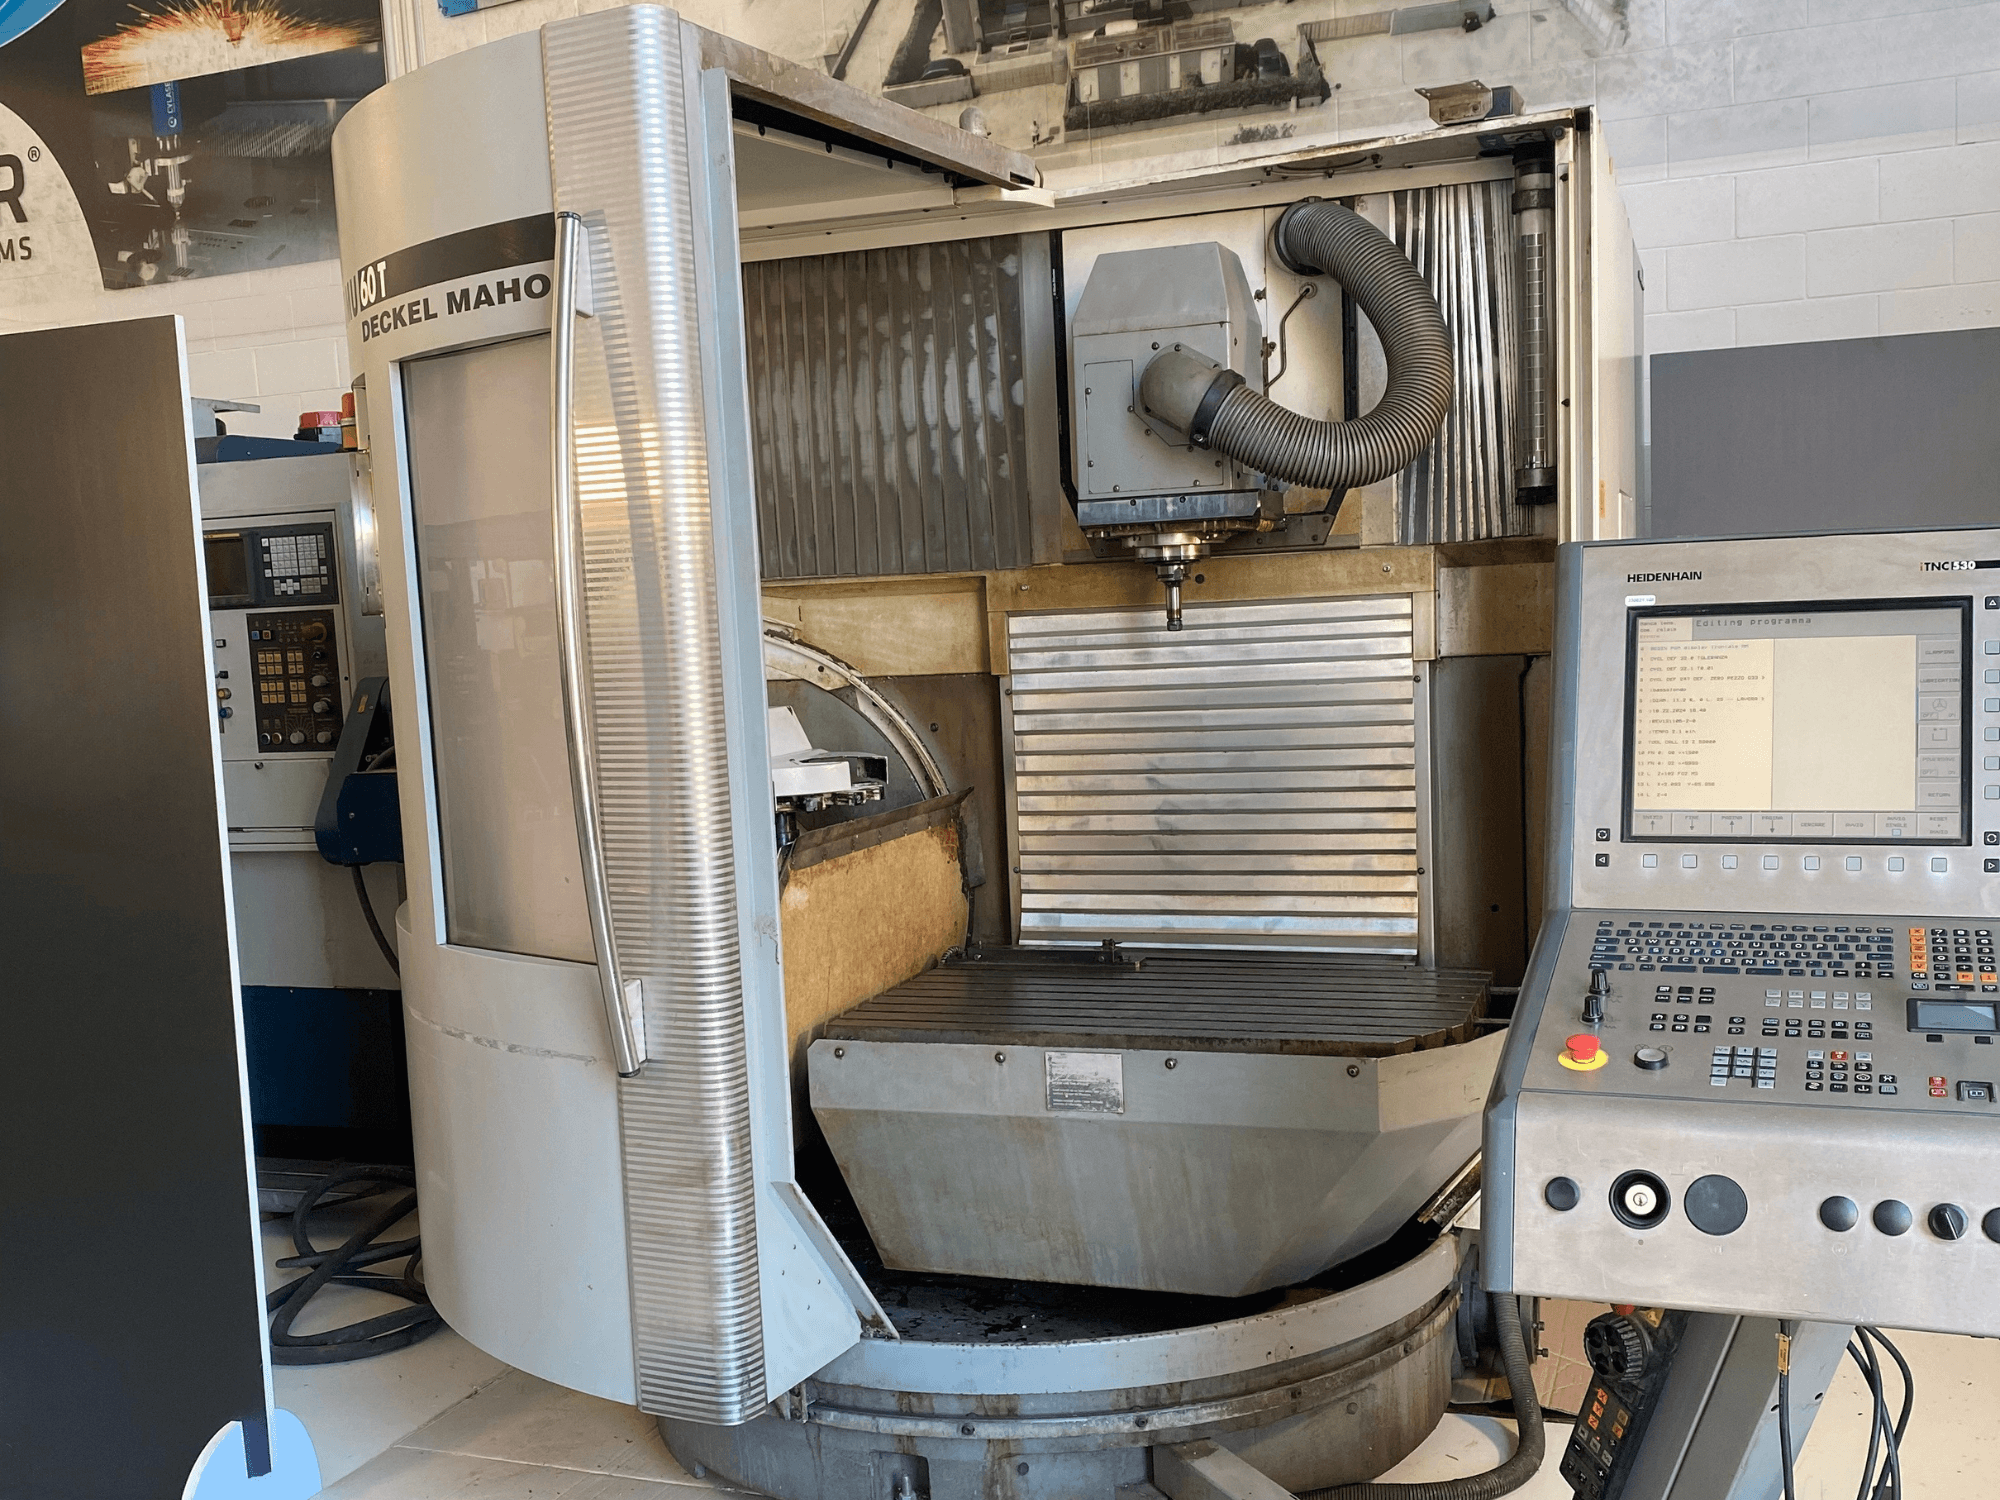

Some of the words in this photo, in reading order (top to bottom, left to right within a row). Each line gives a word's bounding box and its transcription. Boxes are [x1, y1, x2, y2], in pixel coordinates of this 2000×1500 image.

[360, 260, 387, 307] 60T
[361, 297, 438, 342] DECKEL
[446, 273, 552, 315] MAHO
[1627, 571, 1702, 583] HEIDENHAIN
[1696, 619, 1743, 627] Editing
[1749, 617, 1812, 626] programma
